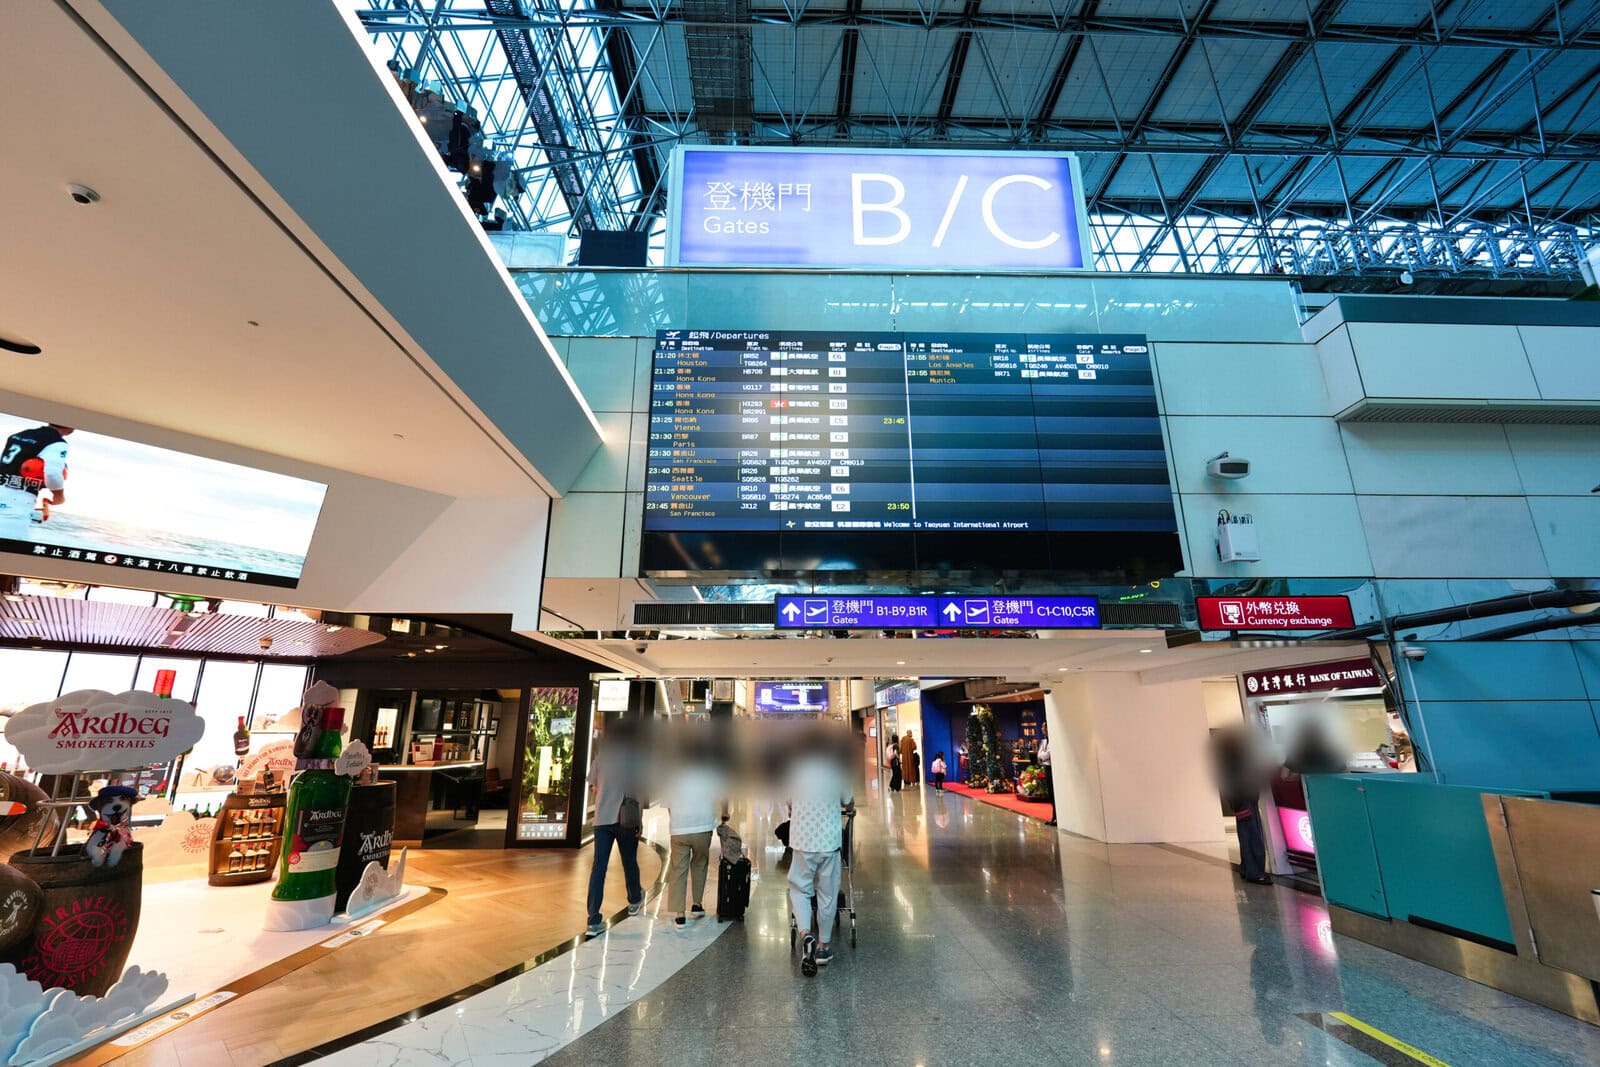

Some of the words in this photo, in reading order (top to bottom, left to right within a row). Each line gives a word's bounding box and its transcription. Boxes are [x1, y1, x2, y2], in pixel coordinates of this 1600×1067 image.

[703, 181, 812, 212] 登機門
[703, 216, 770, 235] Gates
[924, 521, 951, 529] Taoyuan
[1003, 521, 1029, 529] Airport
[33, 544, 98, 562] 禁止酒駕
[831, 599, 874, 614] 登機門
[876, 604, 928, 617] B1-B9,B1R
[992, 599, 1034, 614] 登機門
[1036, 605, 1096, 617] C1-C10,C5R
[832, 615, 859, 625] Gates
[993, 615, 1020, 625] Gates
[1248, 616, 1288, 627] Currency
[1289, 616, 1333, 627] exchange
[1309, 673, 1331, 683] BANK
[1330, 671, 1341, 681] OF
[1341, 668, 1374, 680] TAIWAN
[56, 740, 156, 749] SMOKETRAILS
